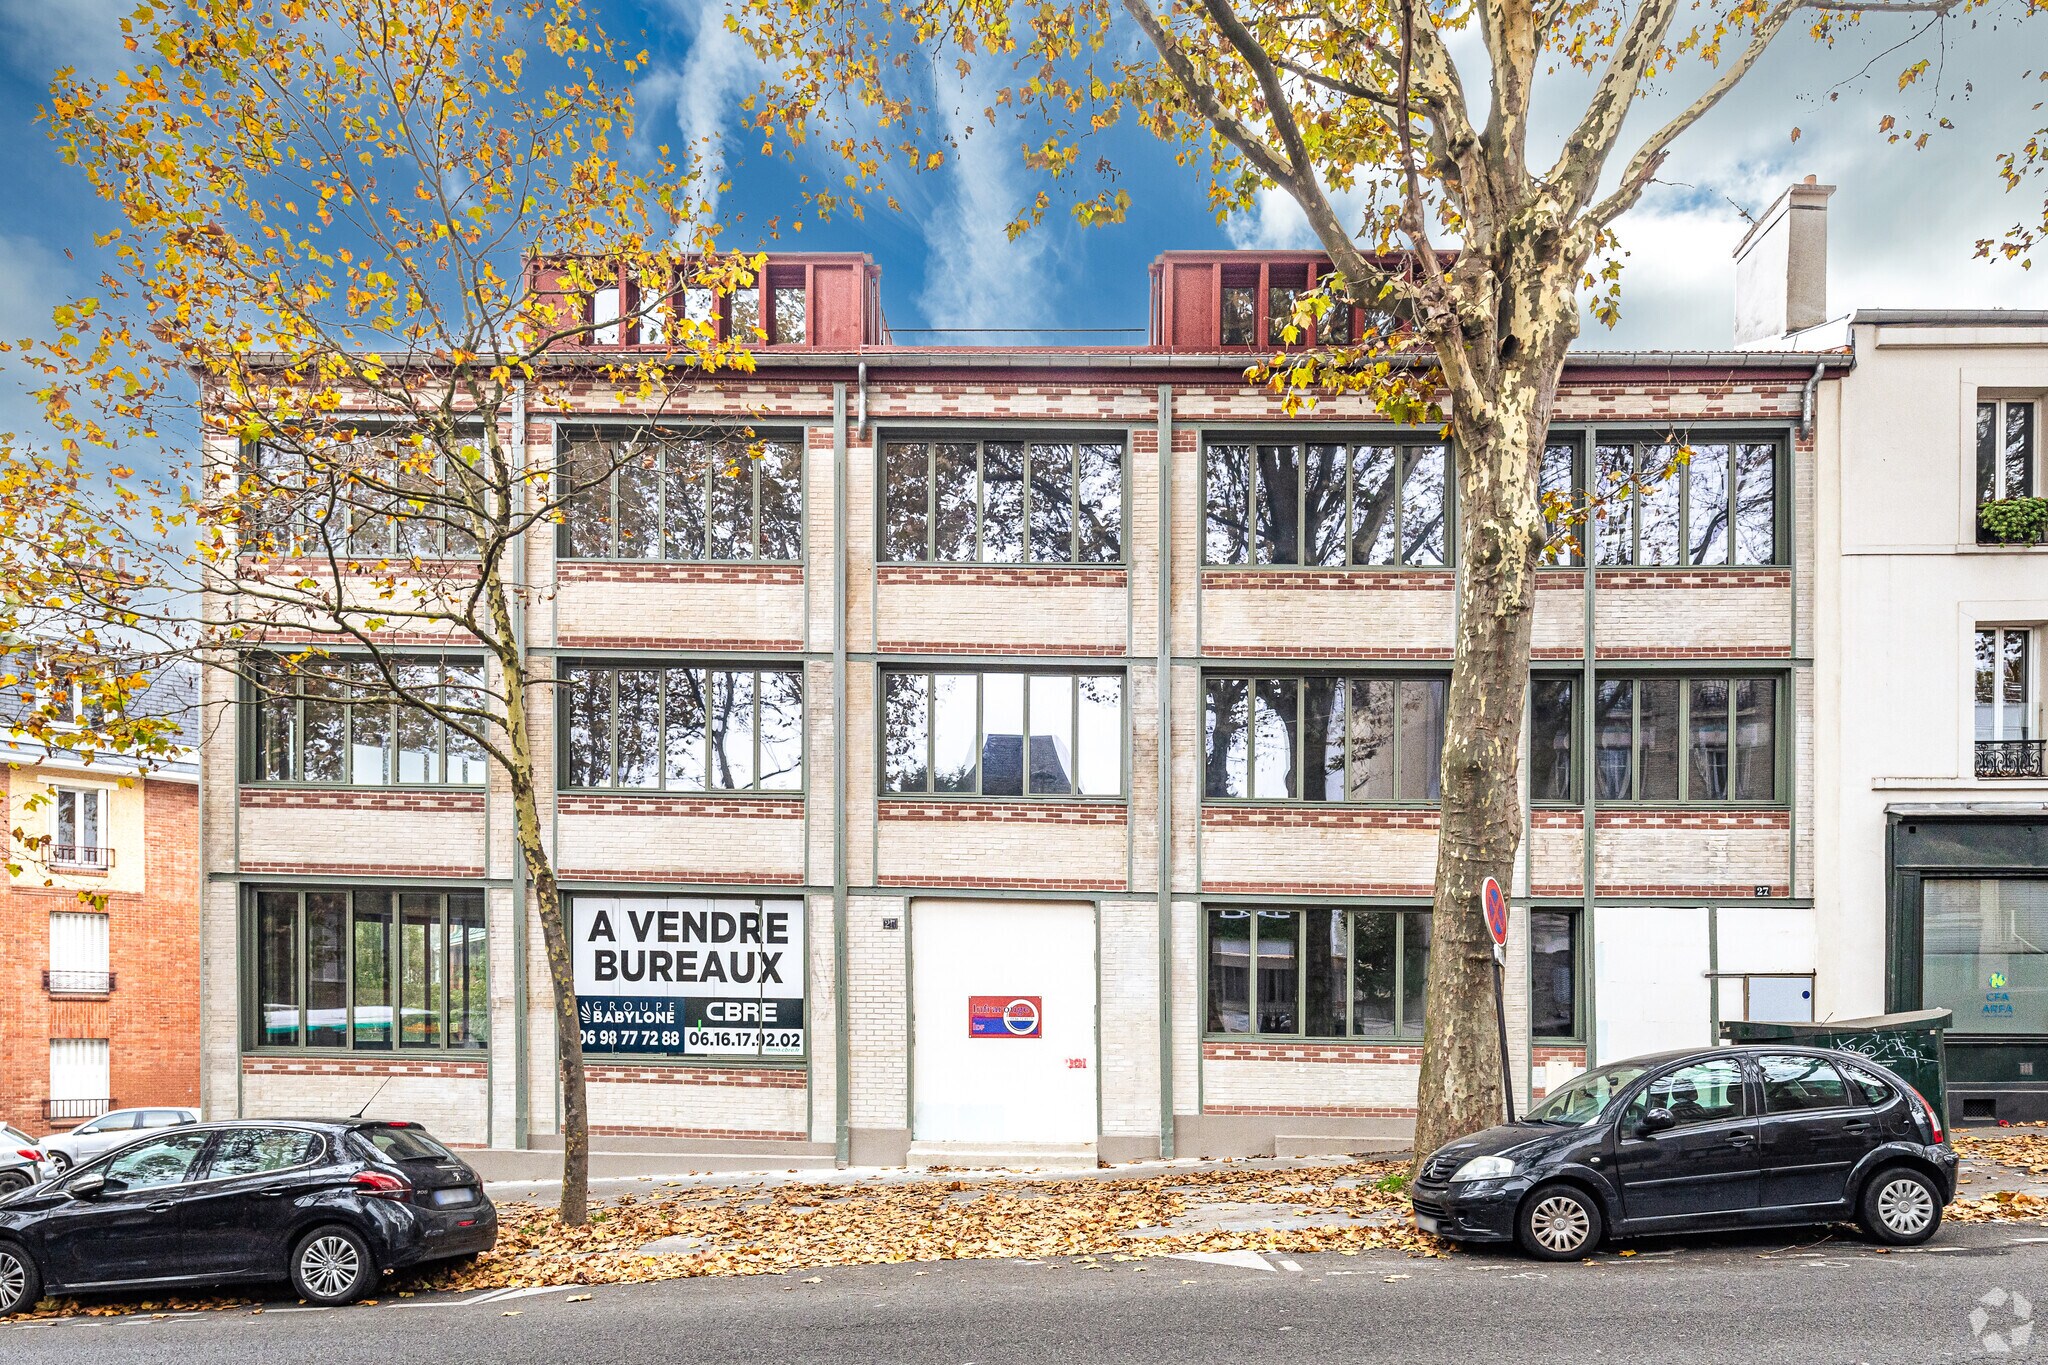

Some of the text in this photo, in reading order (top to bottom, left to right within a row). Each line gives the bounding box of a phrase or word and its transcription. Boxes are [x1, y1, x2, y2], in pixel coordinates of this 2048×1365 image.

[1756, 886, 1769, 896] 27
[588, 910, 788, 944] A VENDRE
[594, 950, 784, 984] BUREAUX
[593, 1001, 675, 1012] GROUPE
[706, 1002, 778, 1022] CBRE
[593, 1011, 675, 1024] BABYLONE
[580, 1030, 680, 1046] 06 98 77 72 88
[689, 1031, 801, 1047] 06.16.17.92.02
